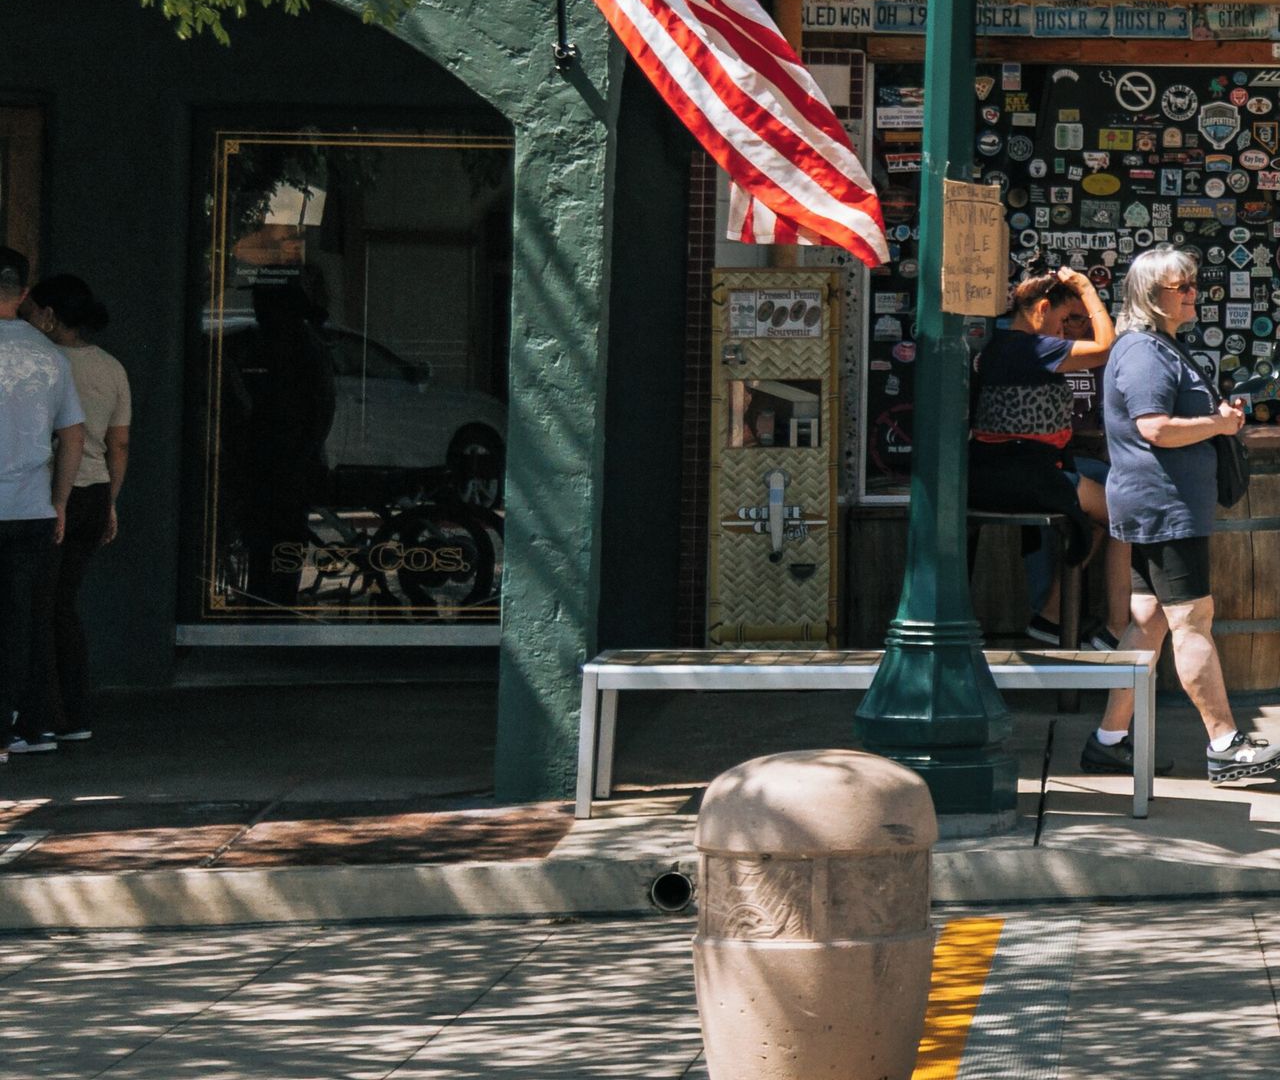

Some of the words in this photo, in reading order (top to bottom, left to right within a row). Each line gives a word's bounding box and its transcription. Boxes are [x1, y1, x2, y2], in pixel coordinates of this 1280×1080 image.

[841, 7, 871, 26] WGN
[1036, 11, 1088, 30] HUSLR
[1100, 11, 1109, 30] 2
[1115, 11, 1167, 30] HUSLR
[1179, 11, 1189, 31] 3
[1152, 202, 1172, 212] RIDE
[1152, 219, 1173, 228] BIKES
[758, 290, 791, 300] Pressed
[794, 290, 821, 301] Penny
[766, 326, 811, 337] Souvenir
[273, 544, 357, 573] Six
[369, 542, 472, 572] Cos.
